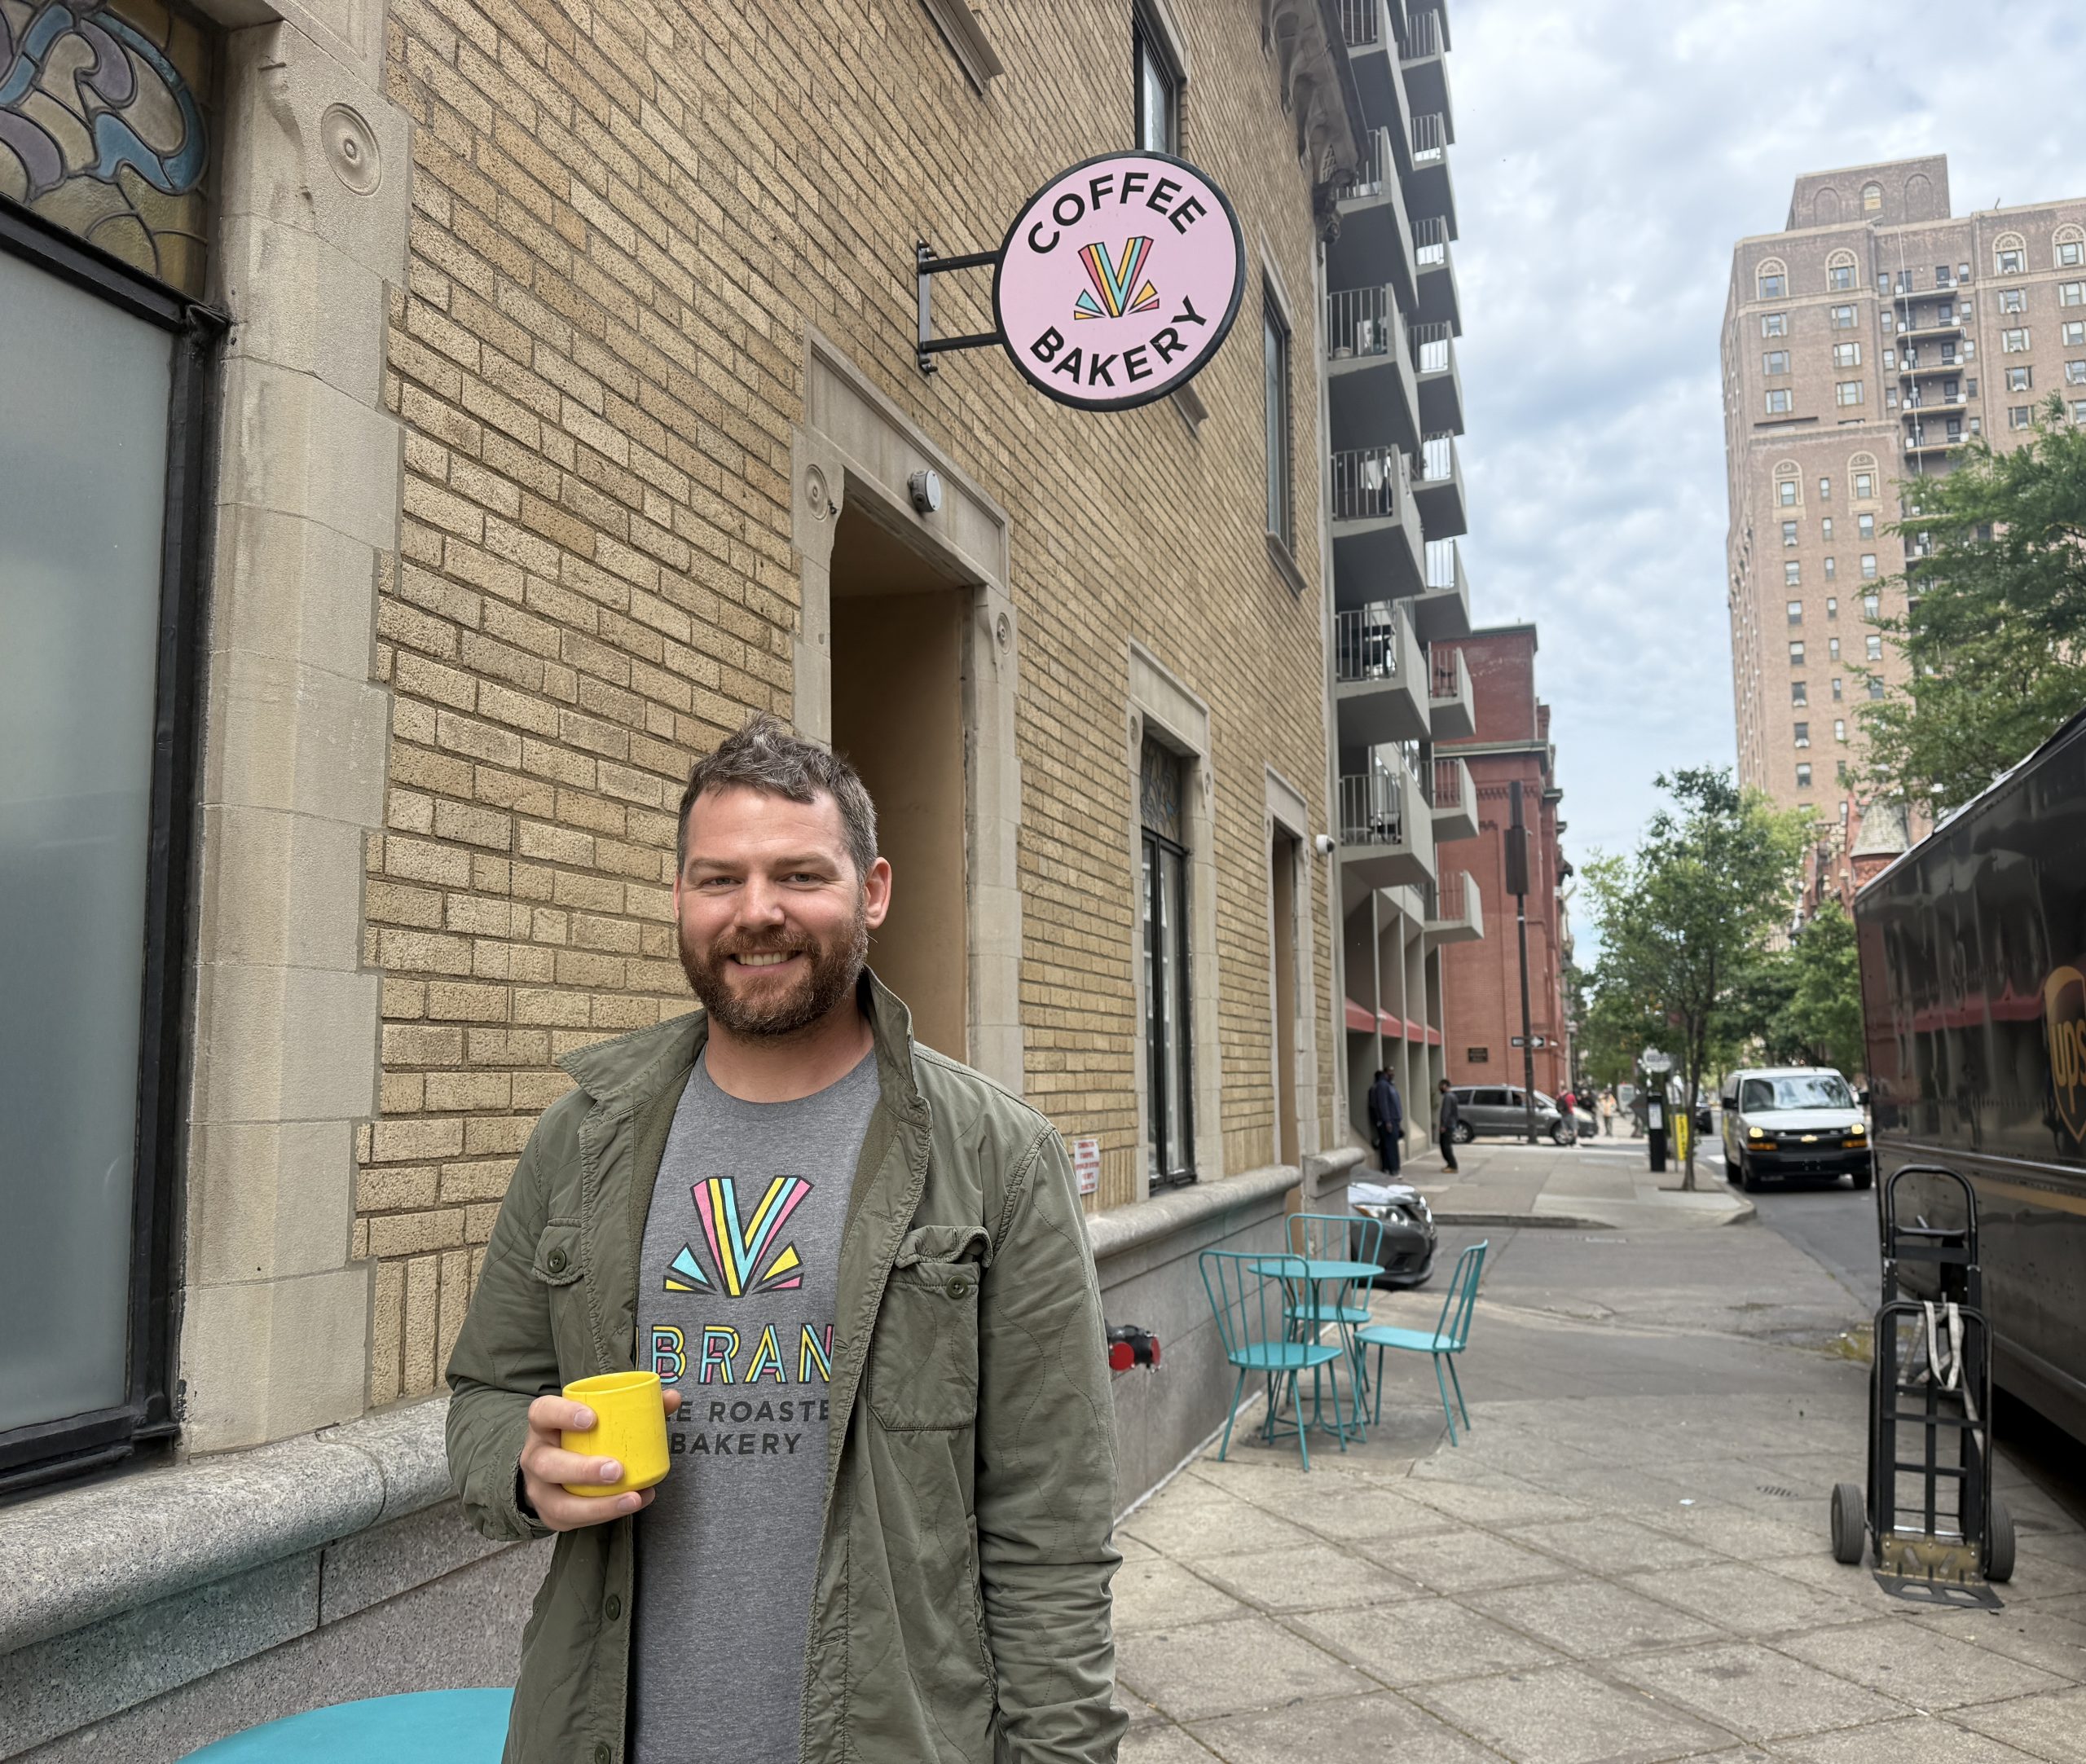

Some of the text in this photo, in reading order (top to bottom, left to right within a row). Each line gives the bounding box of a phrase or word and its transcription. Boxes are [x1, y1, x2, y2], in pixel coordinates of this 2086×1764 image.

[1028, 172, 1208, 254] COFFEE
[1029, 295, 1208, 387] BAKERY
[635, 1323, 835, 1385] BRAN
[670, 1432, 803, 1456] BAKERY
